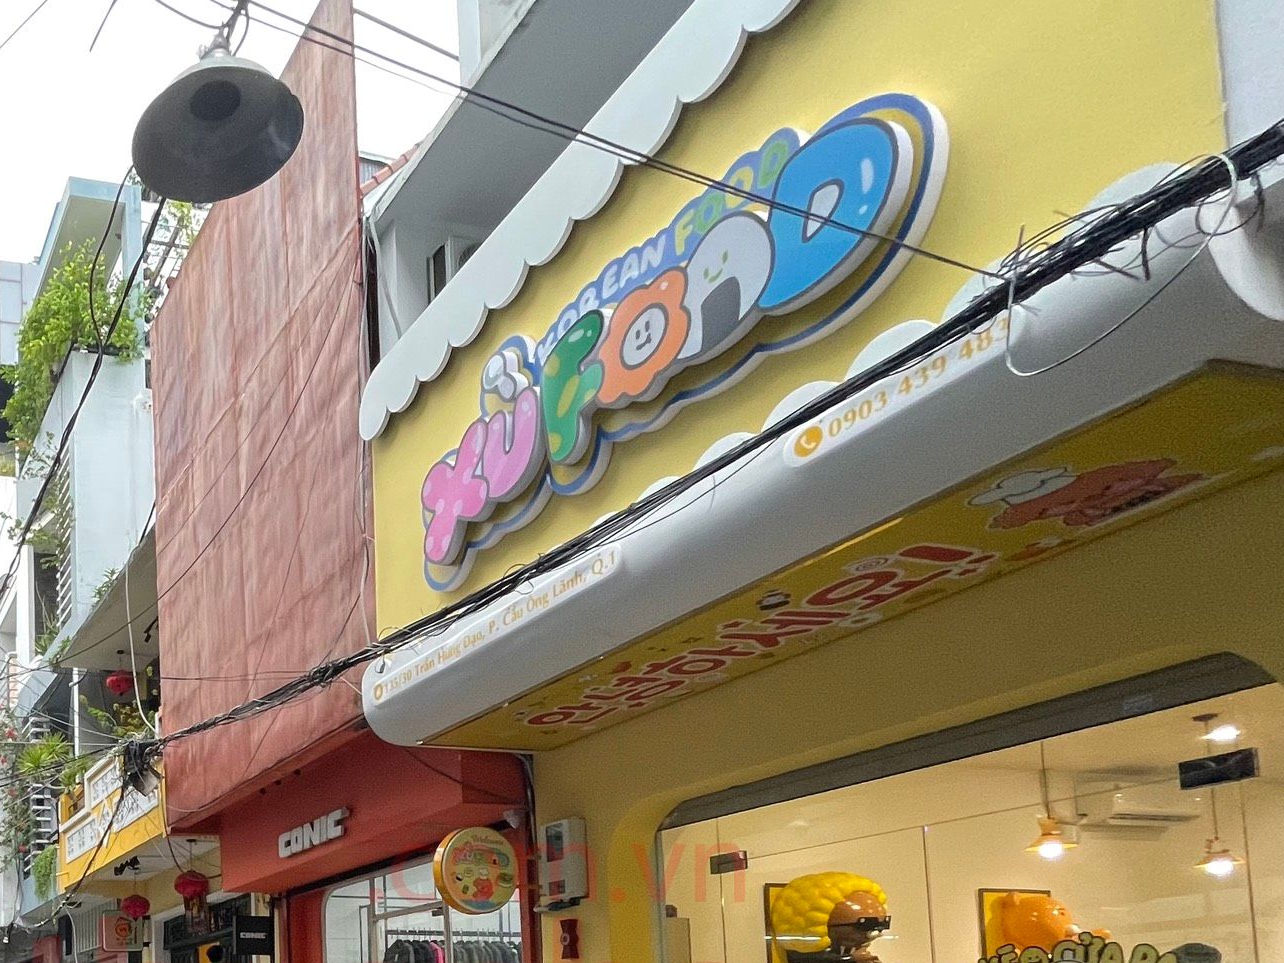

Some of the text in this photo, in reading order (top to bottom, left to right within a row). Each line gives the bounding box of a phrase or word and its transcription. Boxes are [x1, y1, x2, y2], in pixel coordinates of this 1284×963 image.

[536, 139, 790, 368] KOREAN FOOD
[828, 388, 889, 438] 0903
[897, 354, 948, 397] 439
[278, 806, 350, 858] CONIC
